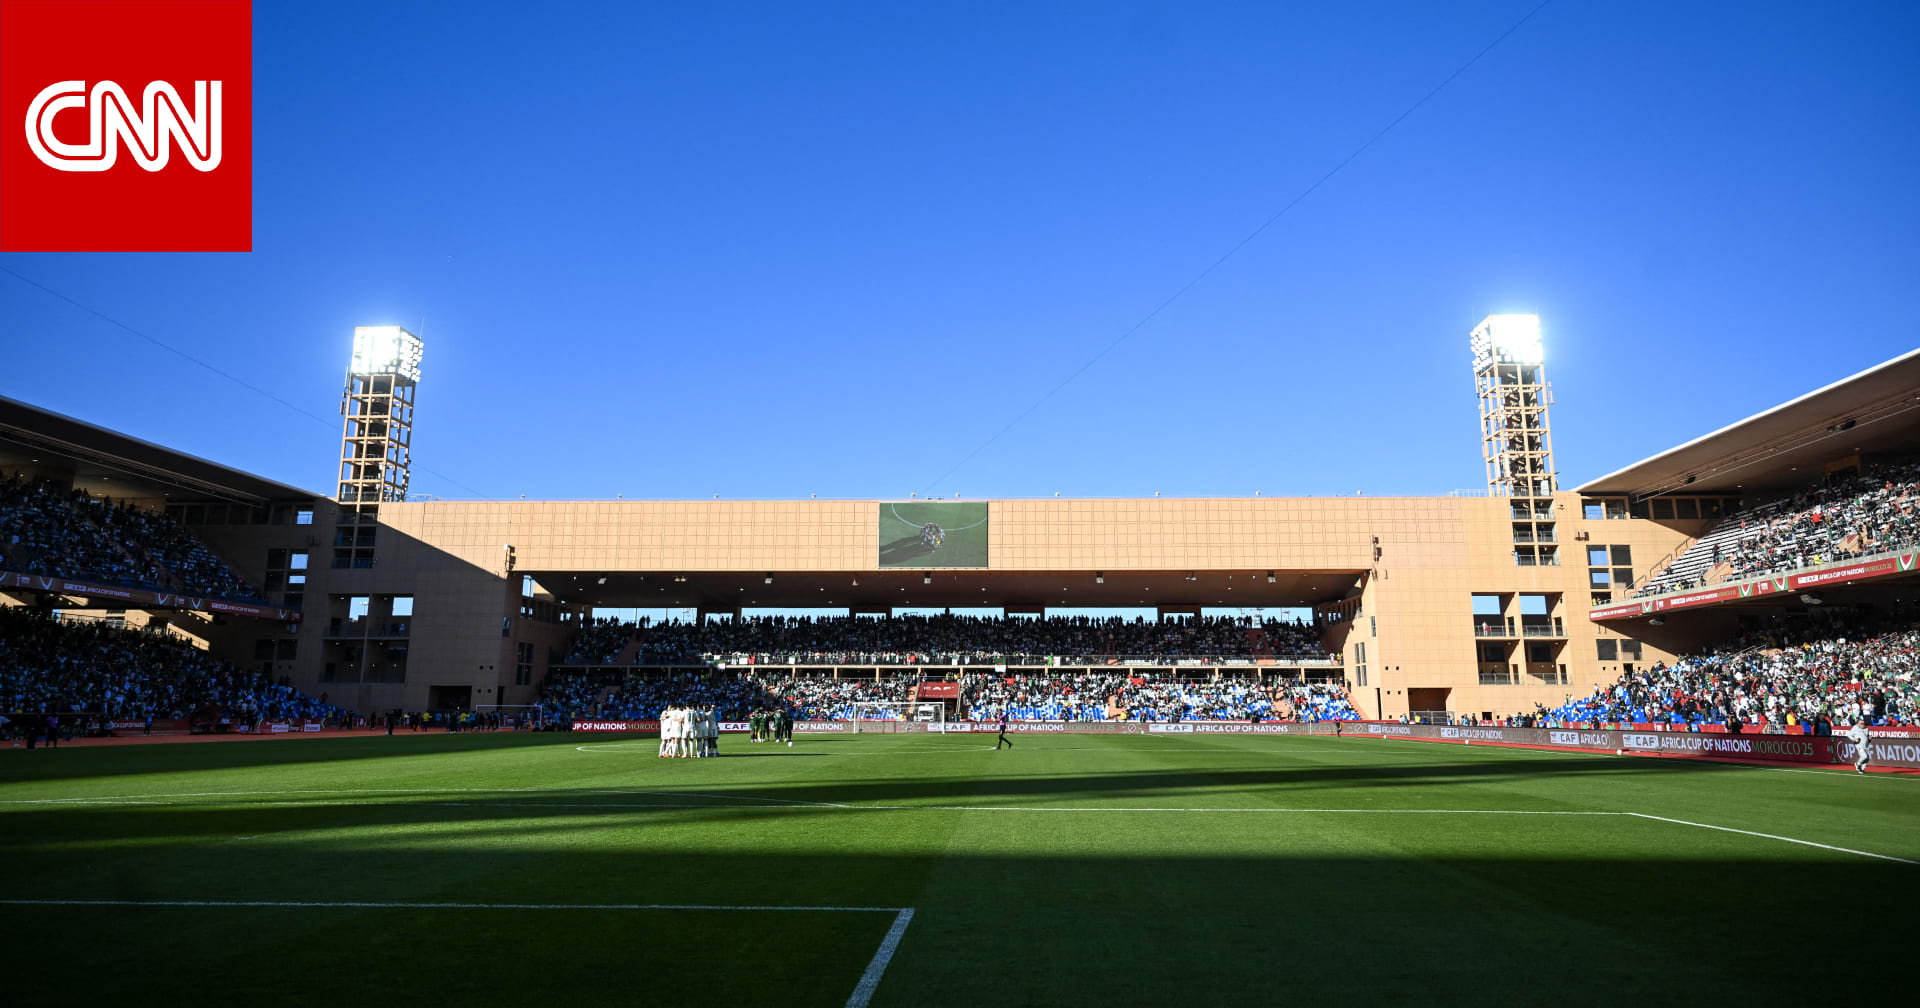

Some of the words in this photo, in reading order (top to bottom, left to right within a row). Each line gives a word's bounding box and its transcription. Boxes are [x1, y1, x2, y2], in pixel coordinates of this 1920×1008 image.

[810, 723, 843, 731] NATIONS
[974, 723, 1001, 731] AFRICA
[1030, 724, 1064, 732] NATIONS
[1560, 734, 1577, 743] CAF
[1635, 736, 1655, 747] CAF
[1661, 737, 1686, 749] AFRICA
[1687, 738, 1702, 750] CUP
[1703, 739, 1714, 751] OF
[1715, 739, 1752, 753] NATIONS
[1752, 741, 1801, 755] MOROCCO
[1803, 743, 1814, 756] 25
